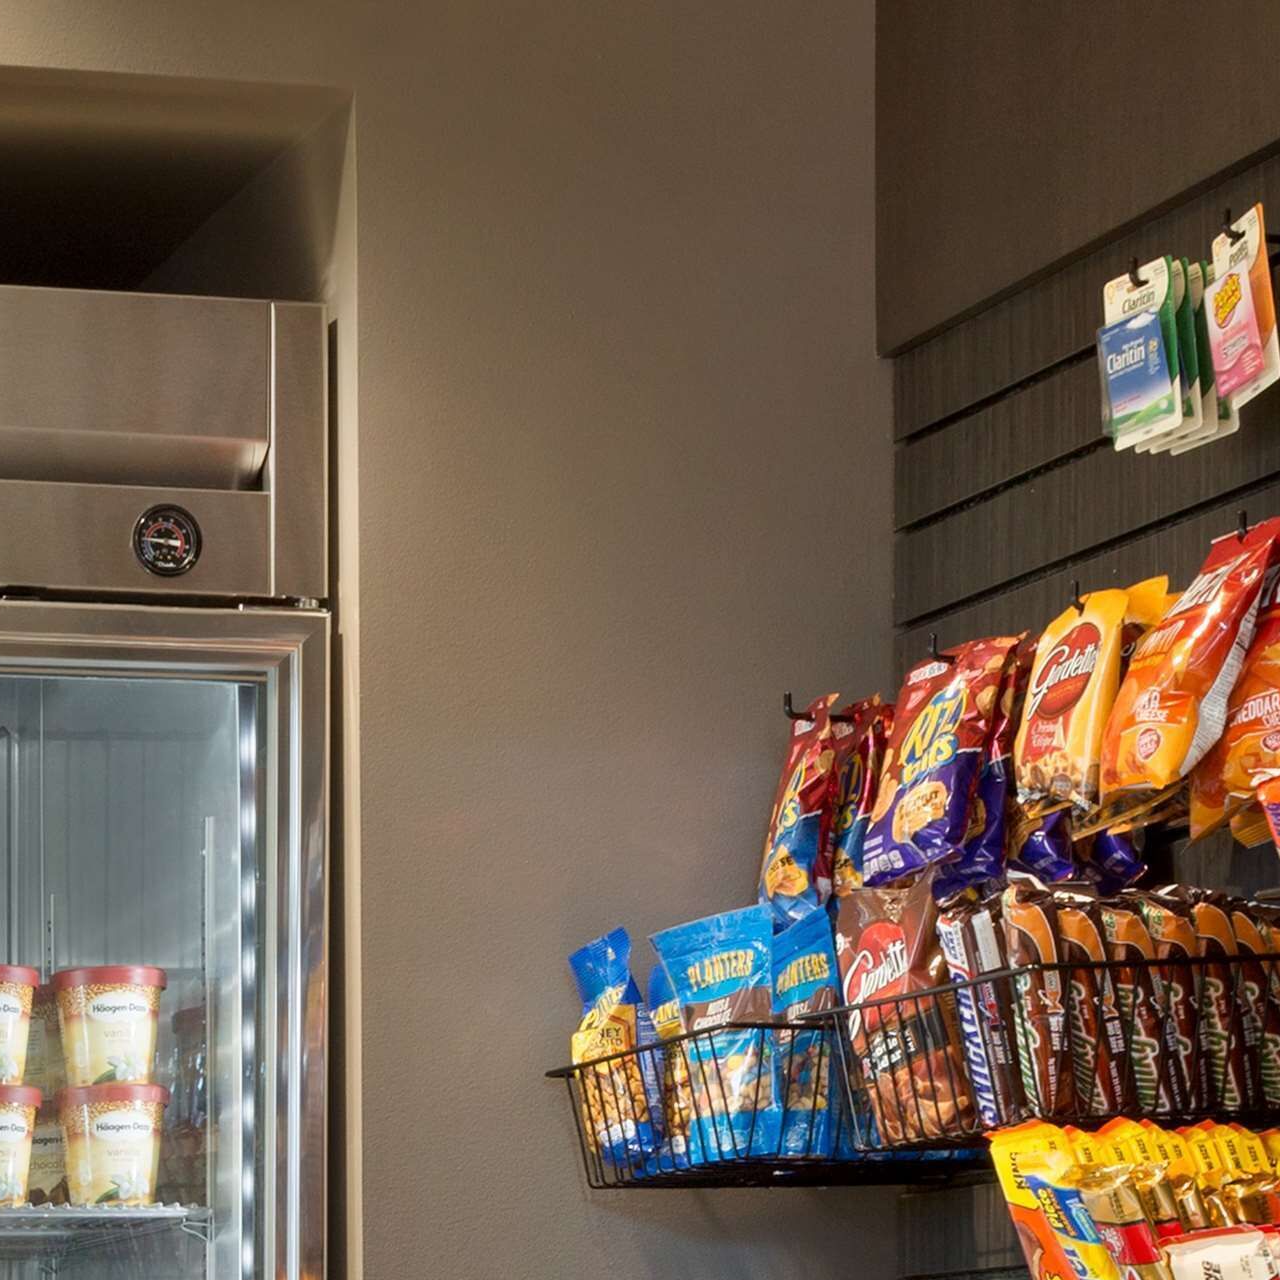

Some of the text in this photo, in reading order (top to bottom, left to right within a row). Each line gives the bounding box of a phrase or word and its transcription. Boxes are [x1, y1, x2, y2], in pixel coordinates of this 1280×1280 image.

[1122, 291, 1156, 314] Claritin
[1106, 344, 1146, 375] Claritin
[687, 949, 756, 991] PLANTERS
